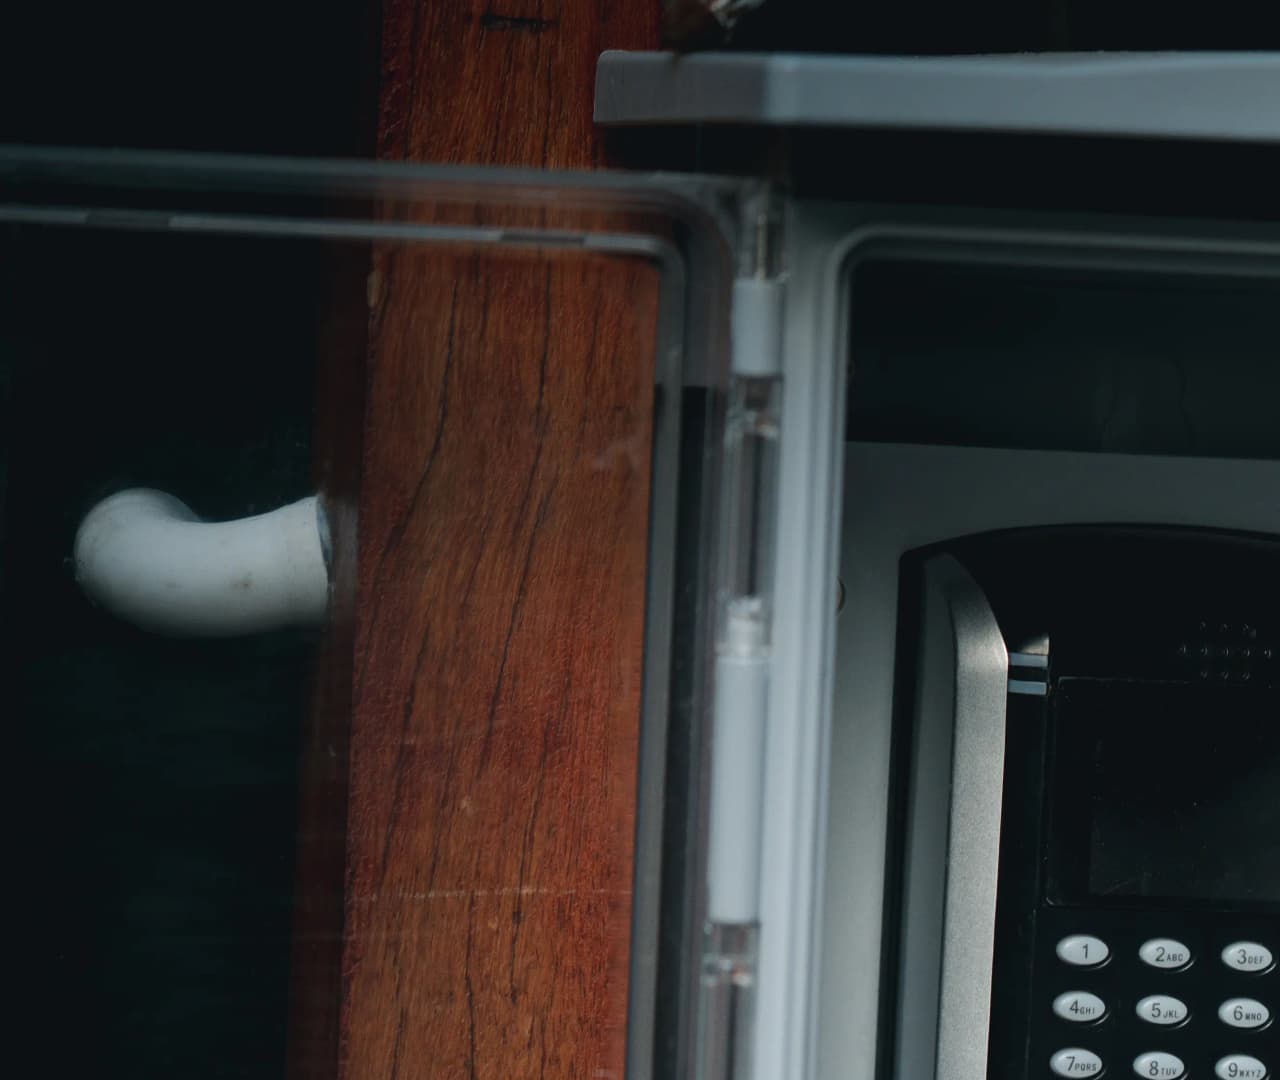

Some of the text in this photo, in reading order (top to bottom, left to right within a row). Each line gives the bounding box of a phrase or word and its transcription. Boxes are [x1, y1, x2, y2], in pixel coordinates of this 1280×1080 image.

[1082, 943, 1089, 960] 1
[1155, 946, 1166, 962] 2
[1236, 949, 1247, 965] 3
[1069, 1000, 1079, 1014] 4
[1151, 1002, 1162, 1018] 5
[1233, 1005, 1243, 1021] 6
[1065, 1056, 1075, 1071] 7
[1149, 1060, 1159, 1076] 8
[1228, 1062, 1238, 1078] 9
